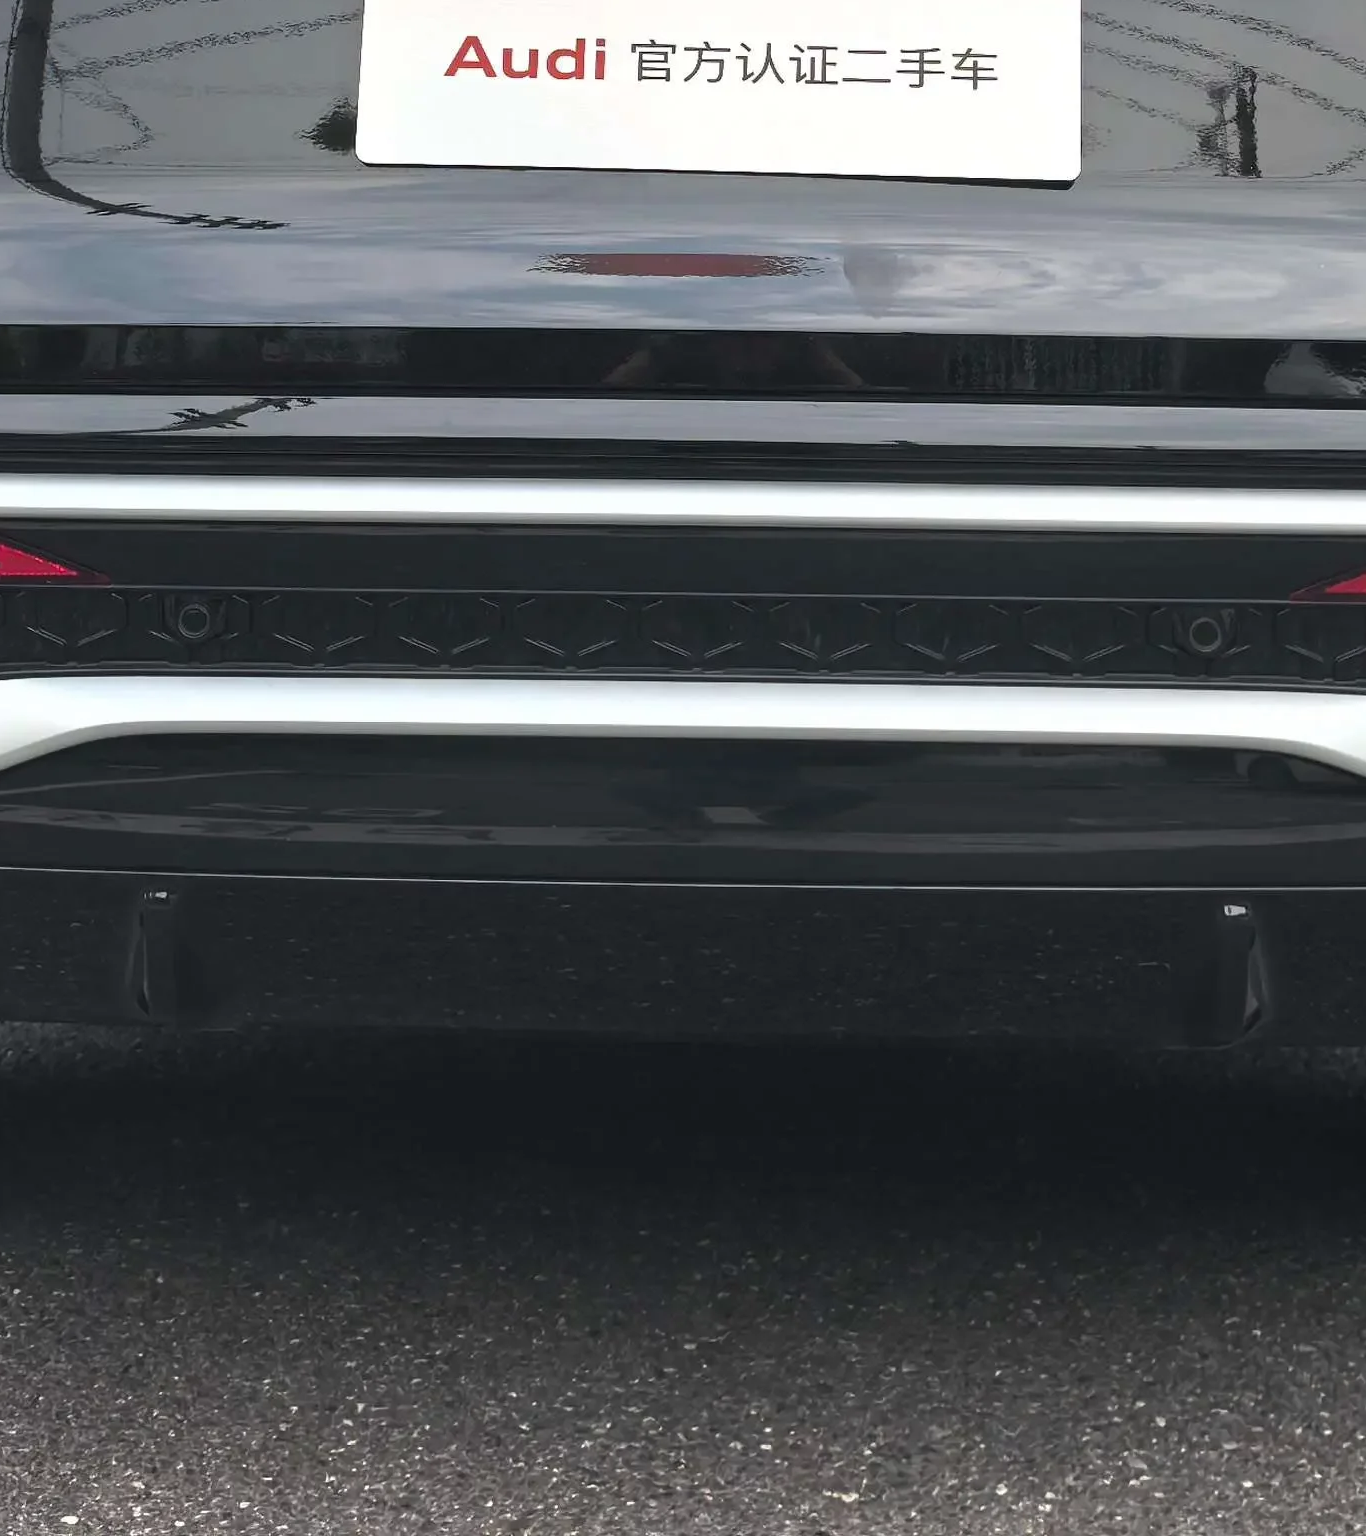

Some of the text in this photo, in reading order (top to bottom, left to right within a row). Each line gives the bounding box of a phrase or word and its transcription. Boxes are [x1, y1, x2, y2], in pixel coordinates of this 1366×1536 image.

[444, 36, 606, 81] Audi
[630, 39, 999, 91] 官方认证二手车
